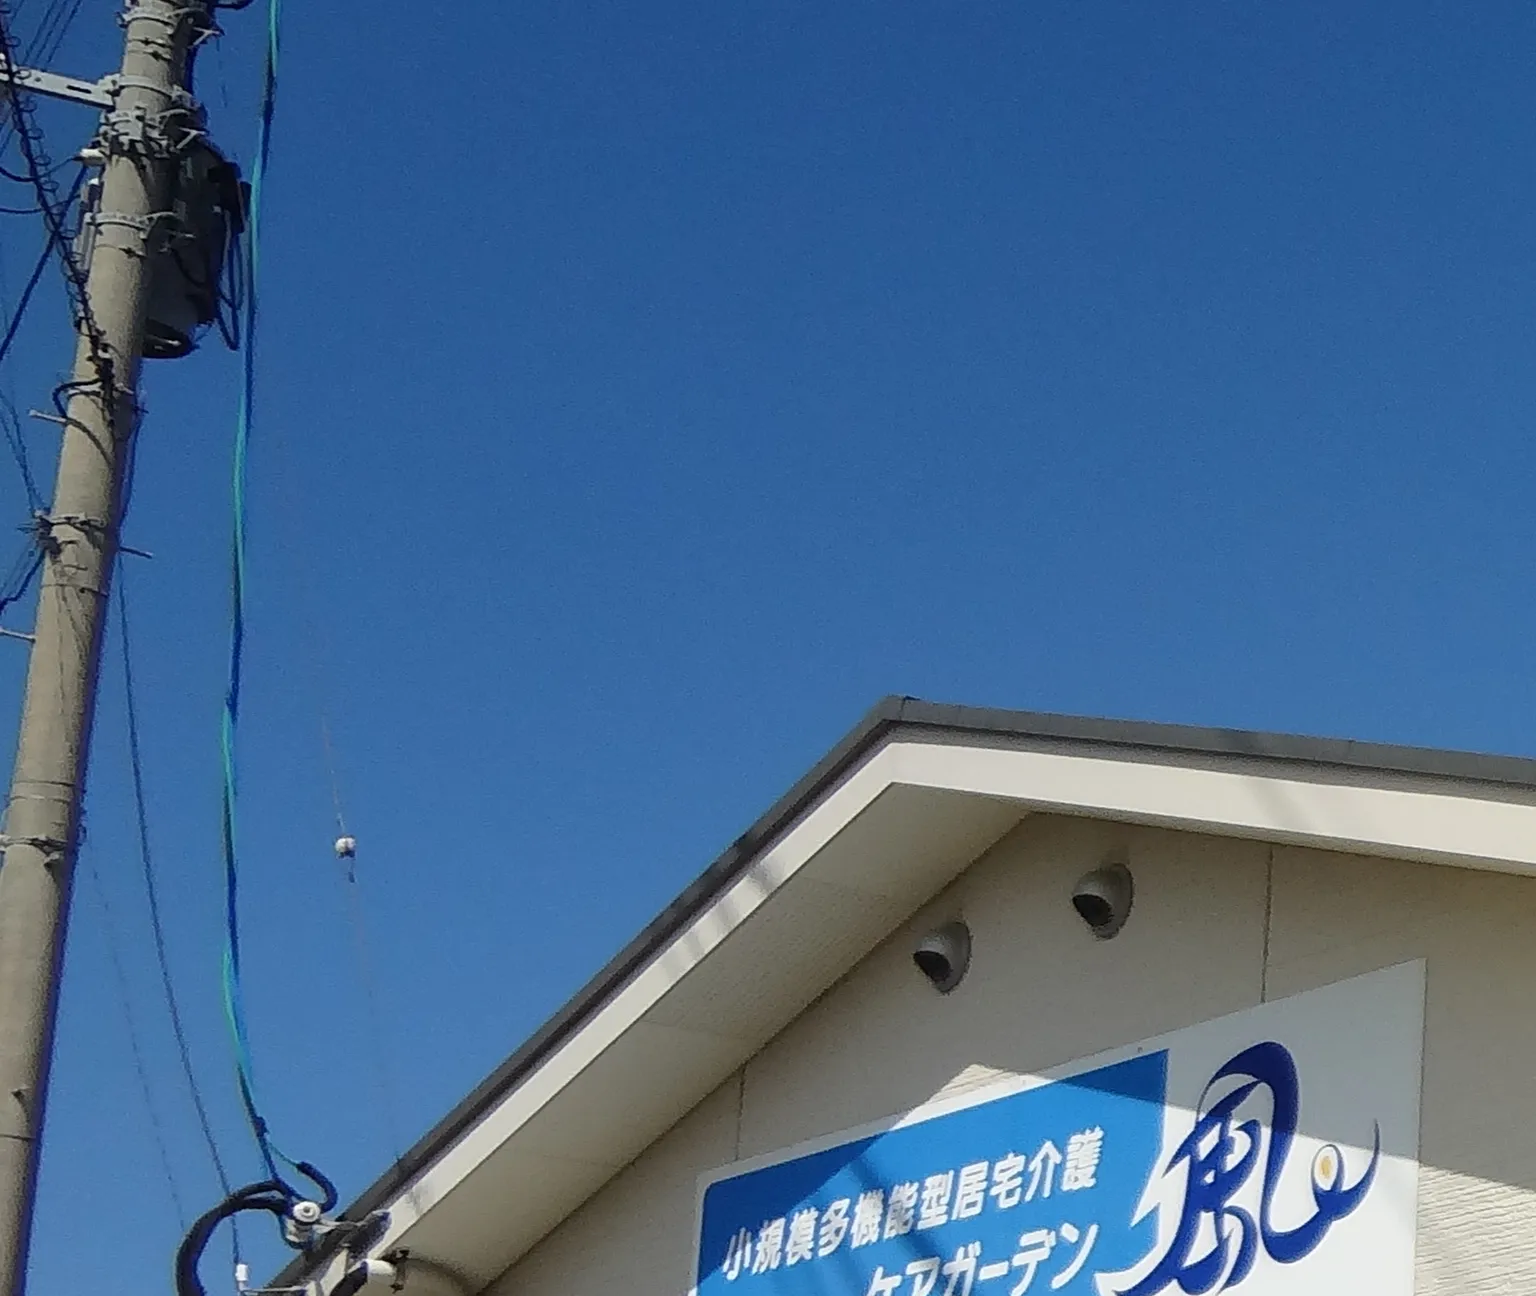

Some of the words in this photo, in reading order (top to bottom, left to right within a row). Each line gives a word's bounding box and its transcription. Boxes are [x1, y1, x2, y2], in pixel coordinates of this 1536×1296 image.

[722, 1125, 1105, 1282] 小規模多機能型居宅介護
